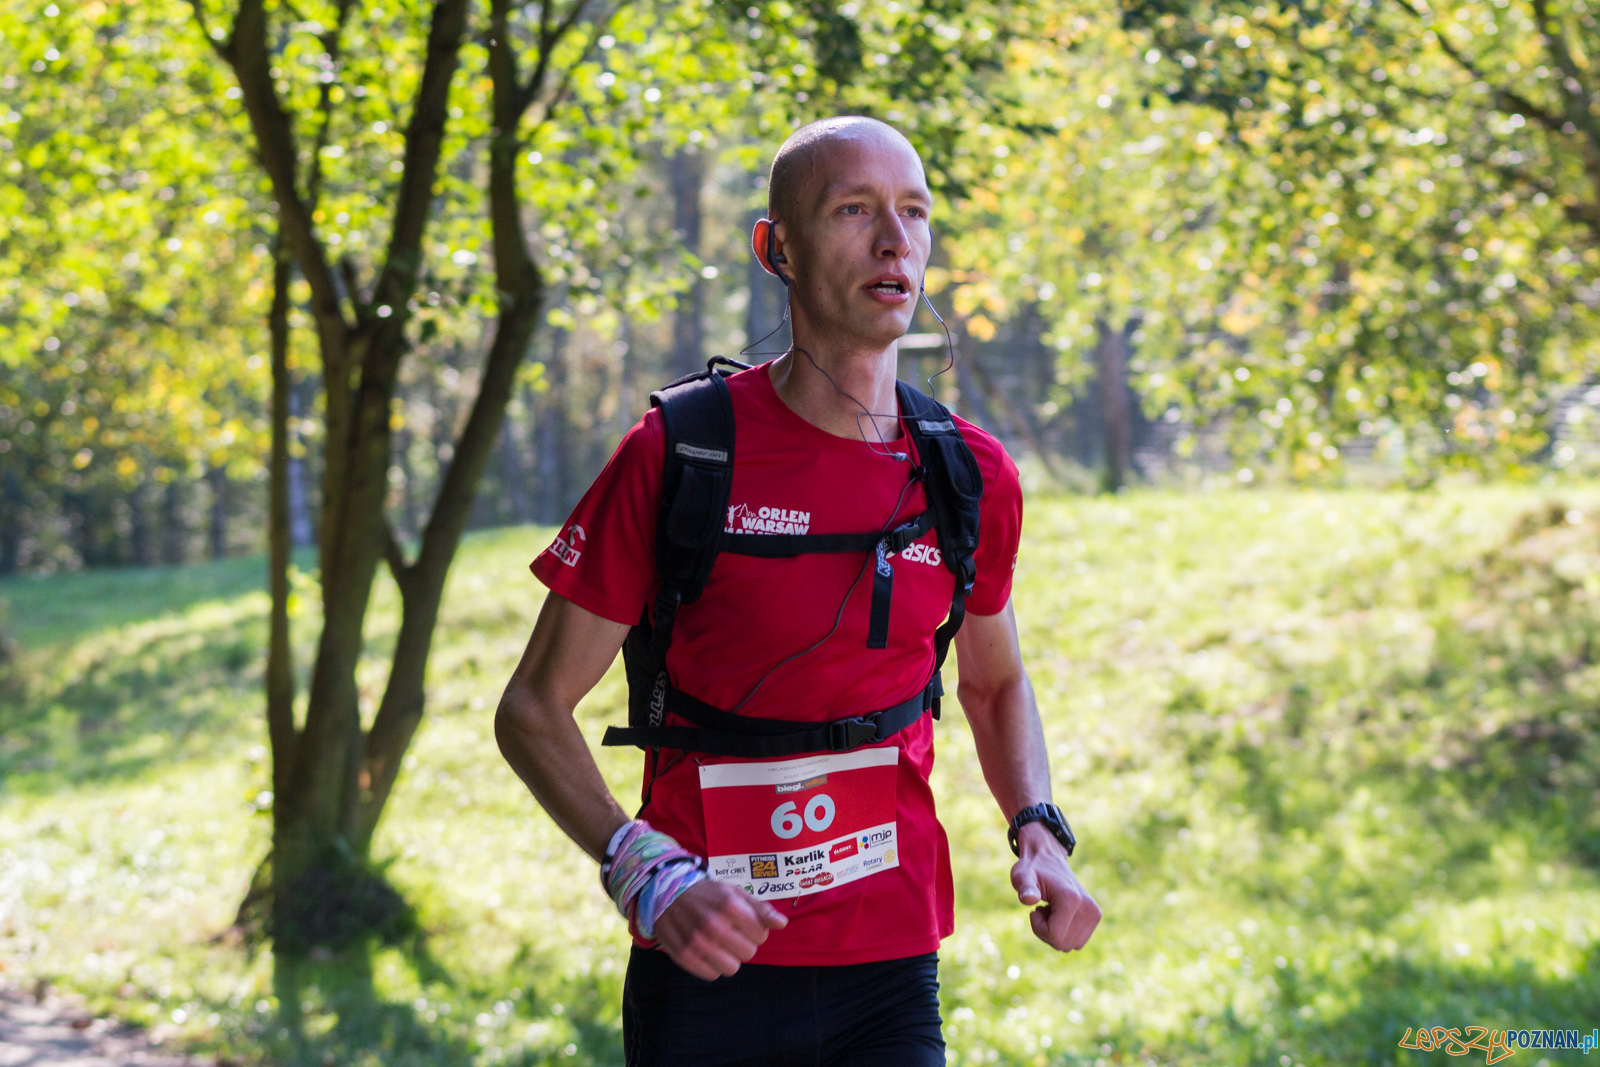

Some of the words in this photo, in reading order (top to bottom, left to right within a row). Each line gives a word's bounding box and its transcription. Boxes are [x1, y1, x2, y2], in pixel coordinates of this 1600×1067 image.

[680, 446, 708, 457] power
[758, 506, 811, 524] ORLEN
[741, 517, 810, 536] WARSAW
[771, 794, 835, 839] 60
[871, 830, 892, 841] mjp
[784, 850, 825, 866] Karlik
[863, 857, 883, 868] Rotary
[752, 861, 777, 871] 24
[785, 863, 823, 877] POLAR
[753, 870, 778, 878] SEVEN
